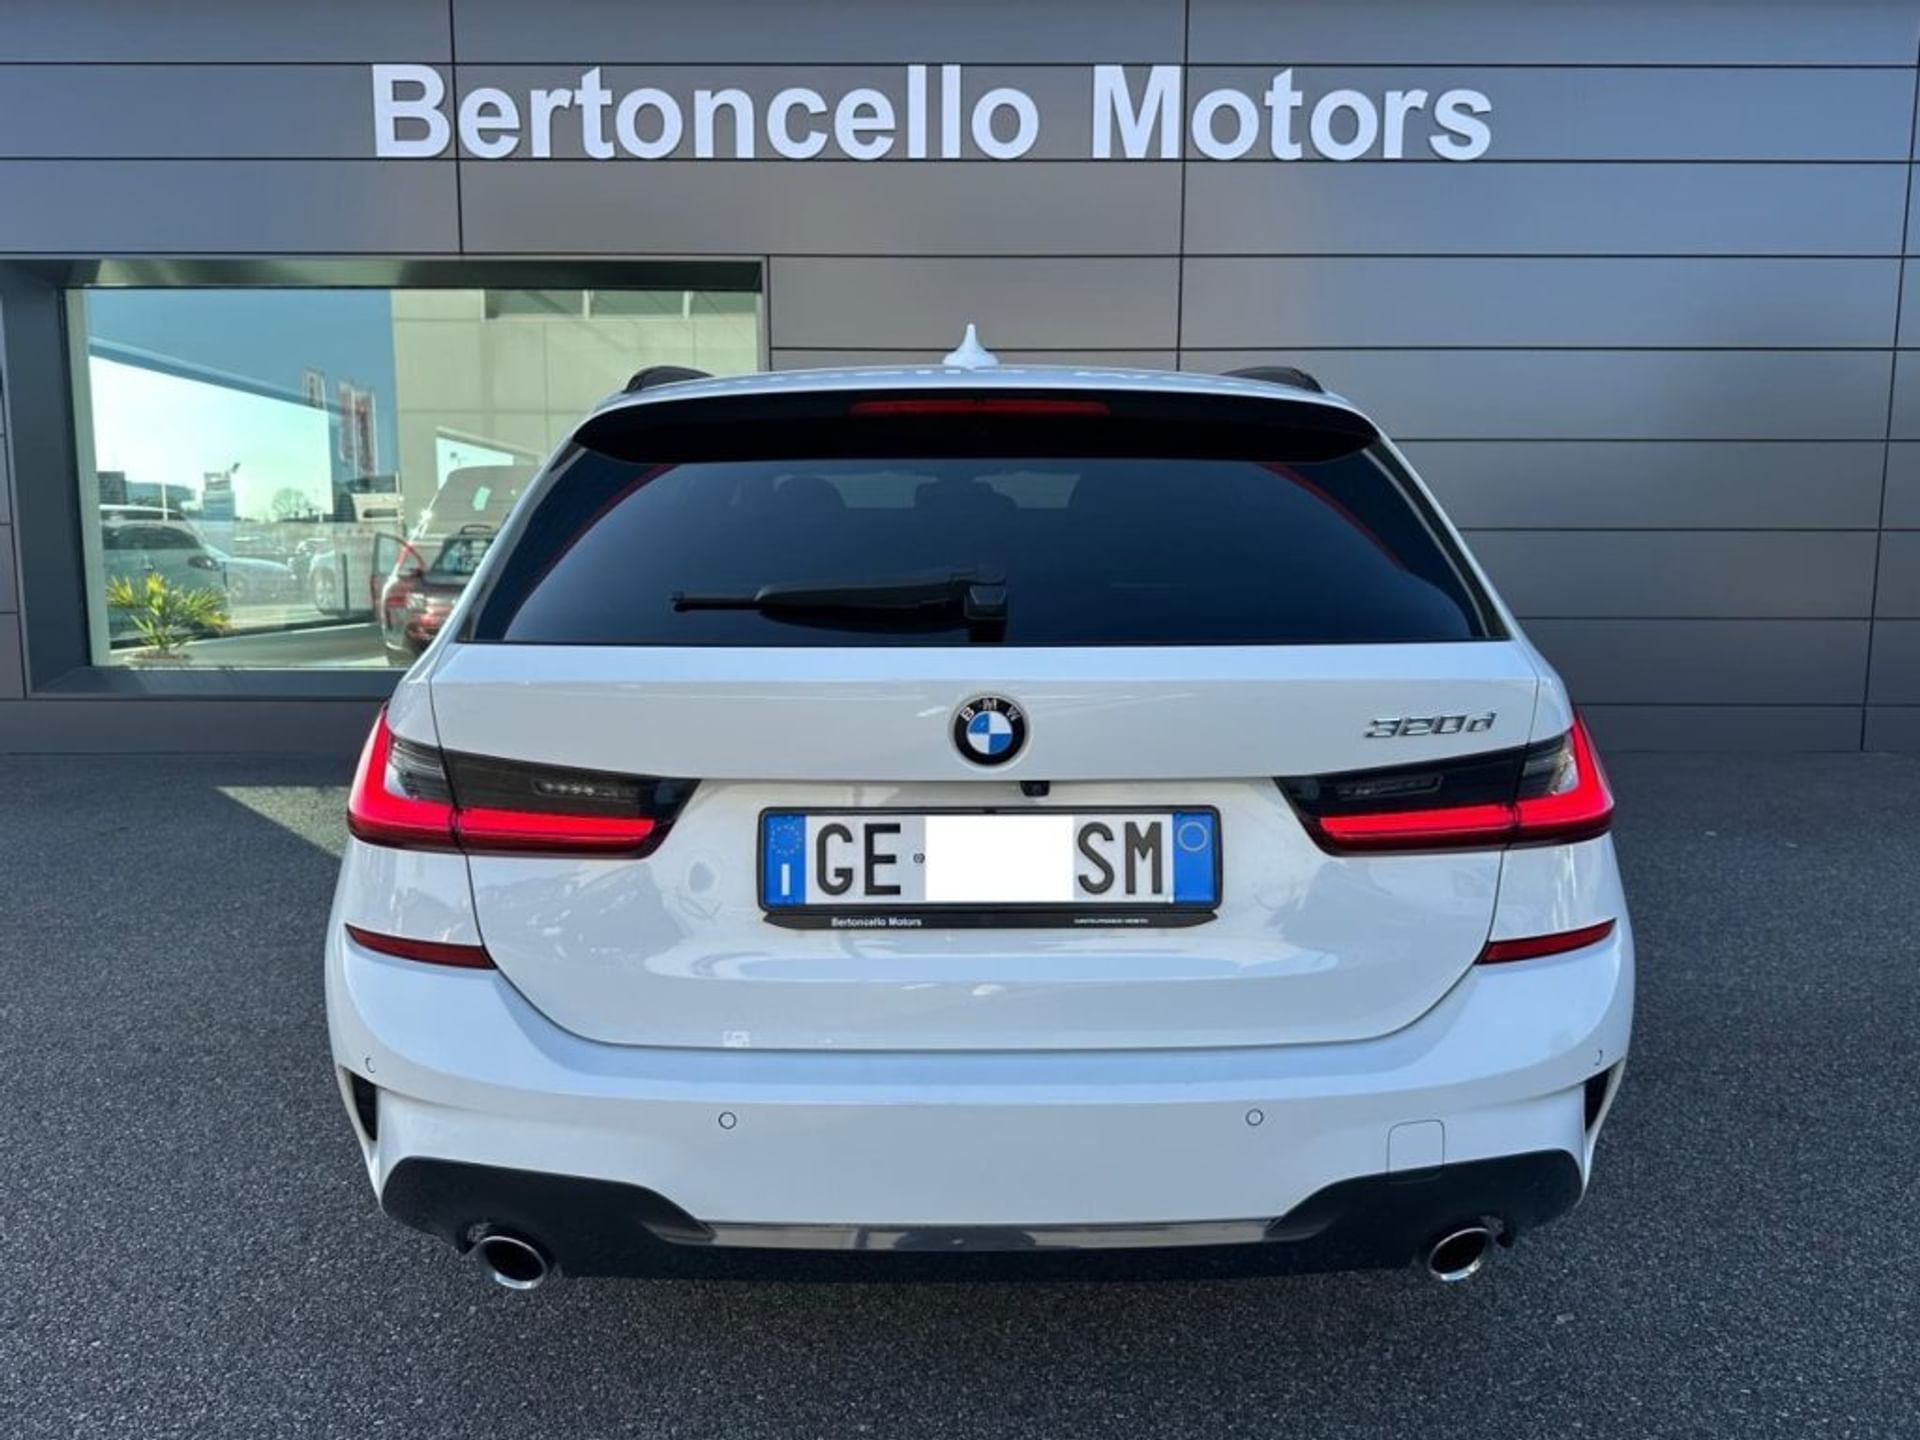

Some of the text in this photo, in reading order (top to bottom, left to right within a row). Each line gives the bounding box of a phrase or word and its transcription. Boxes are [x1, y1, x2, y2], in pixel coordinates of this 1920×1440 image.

[371, 63, 1492, 161] Bertoncello Motors
[960, 697, 1023, 722] BMW
[1363, 711, 1497, 739] 320d
[815, 822, 901, 896] GE
[1077, 820, 1164, 895] SM
[888, 917, 923, 927] Motors
